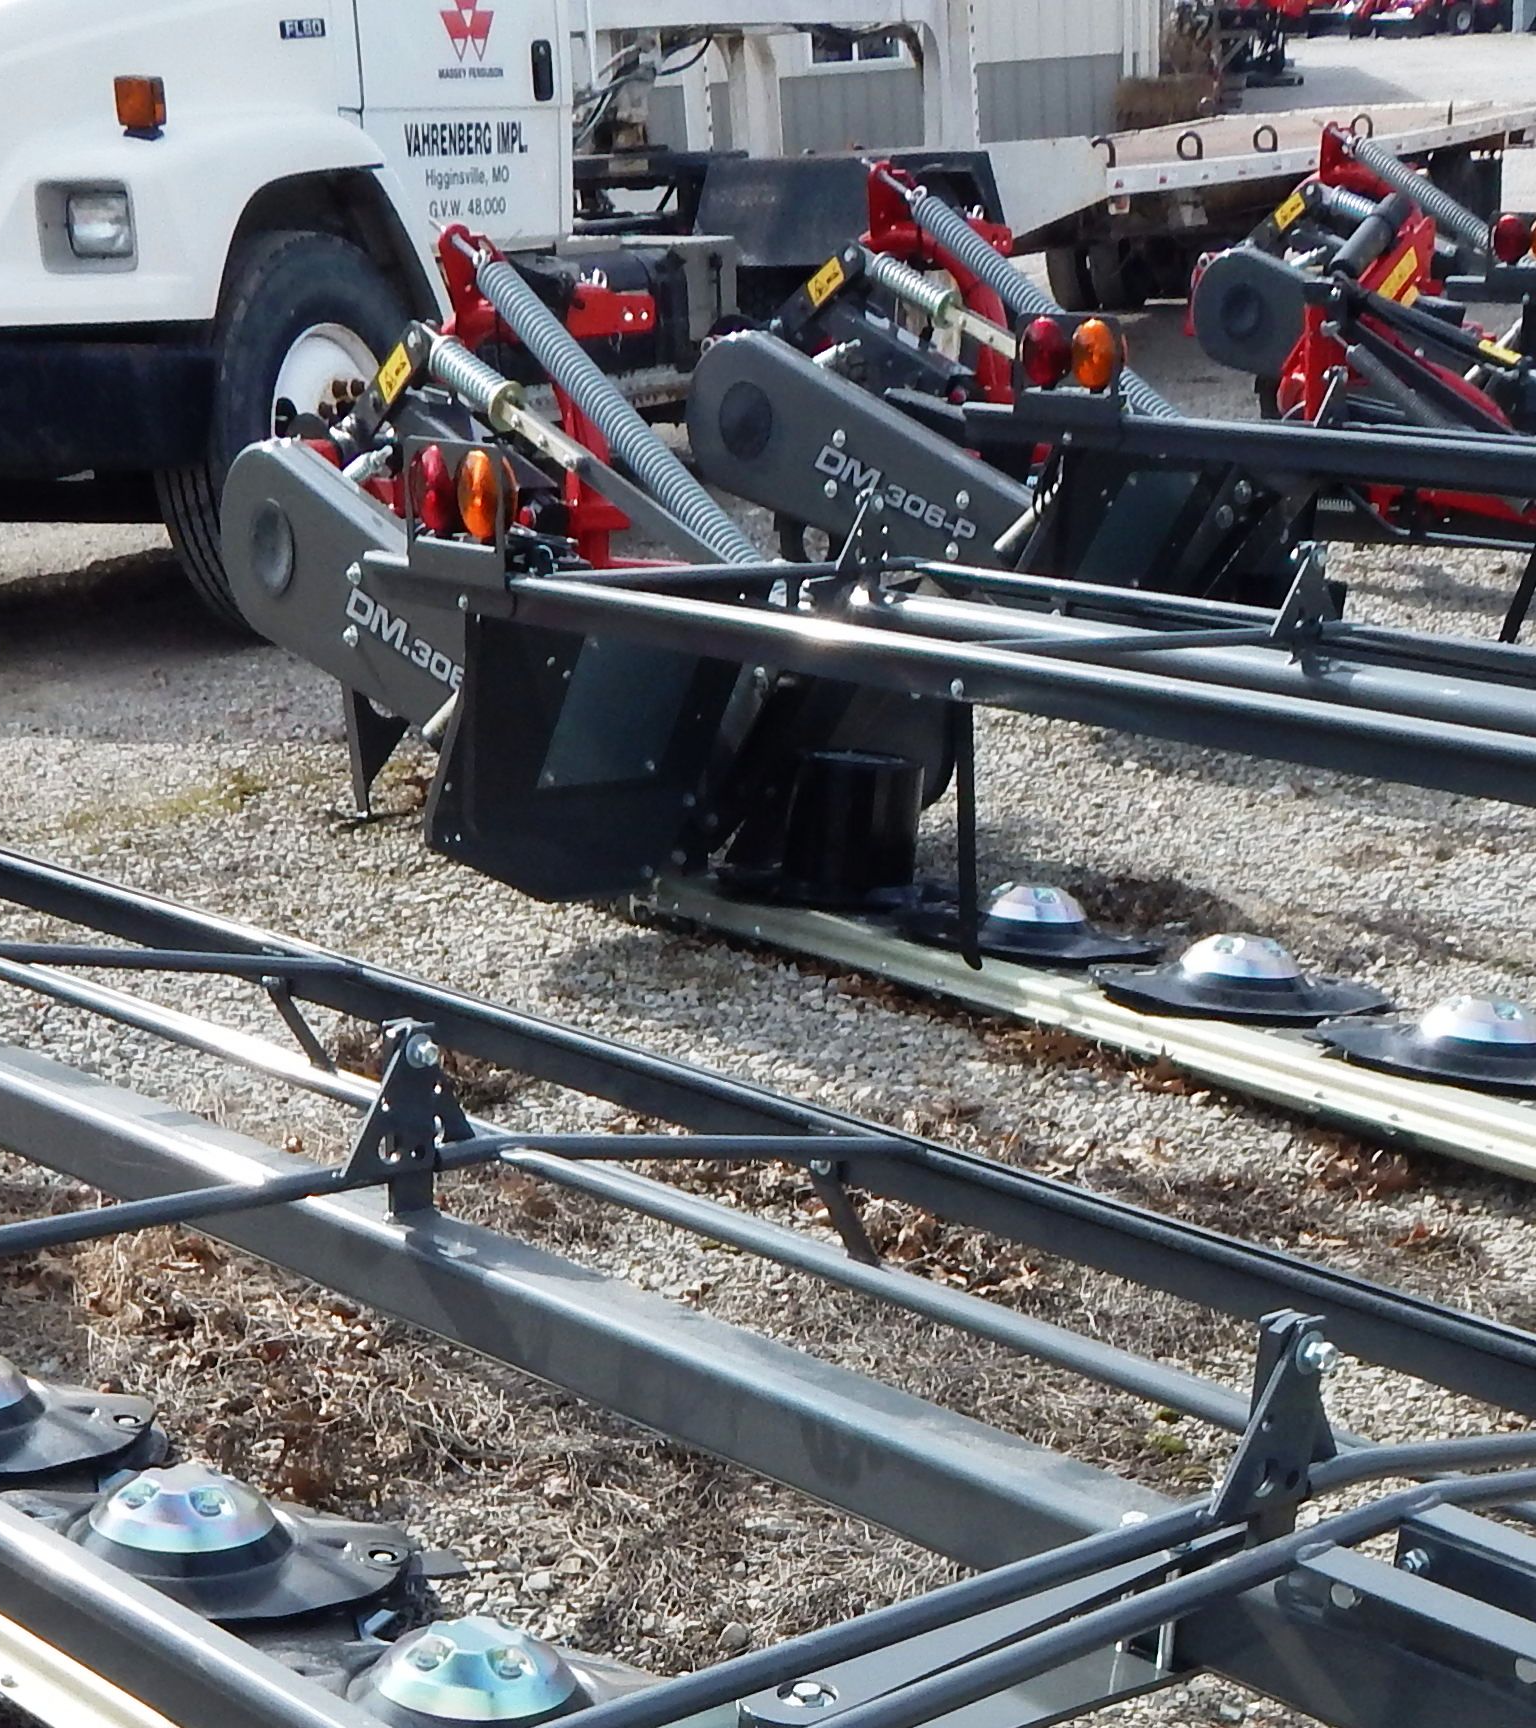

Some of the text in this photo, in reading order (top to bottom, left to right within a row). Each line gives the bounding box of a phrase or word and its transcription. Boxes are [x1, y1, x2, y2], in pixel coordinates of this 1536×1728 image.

[404, 121, 528, 157] VAHRENBERG IMPL.
[425, 164, 510, 190] Higginsville, MO
[429, 196, 507, 218] G.V.W. 48,000
